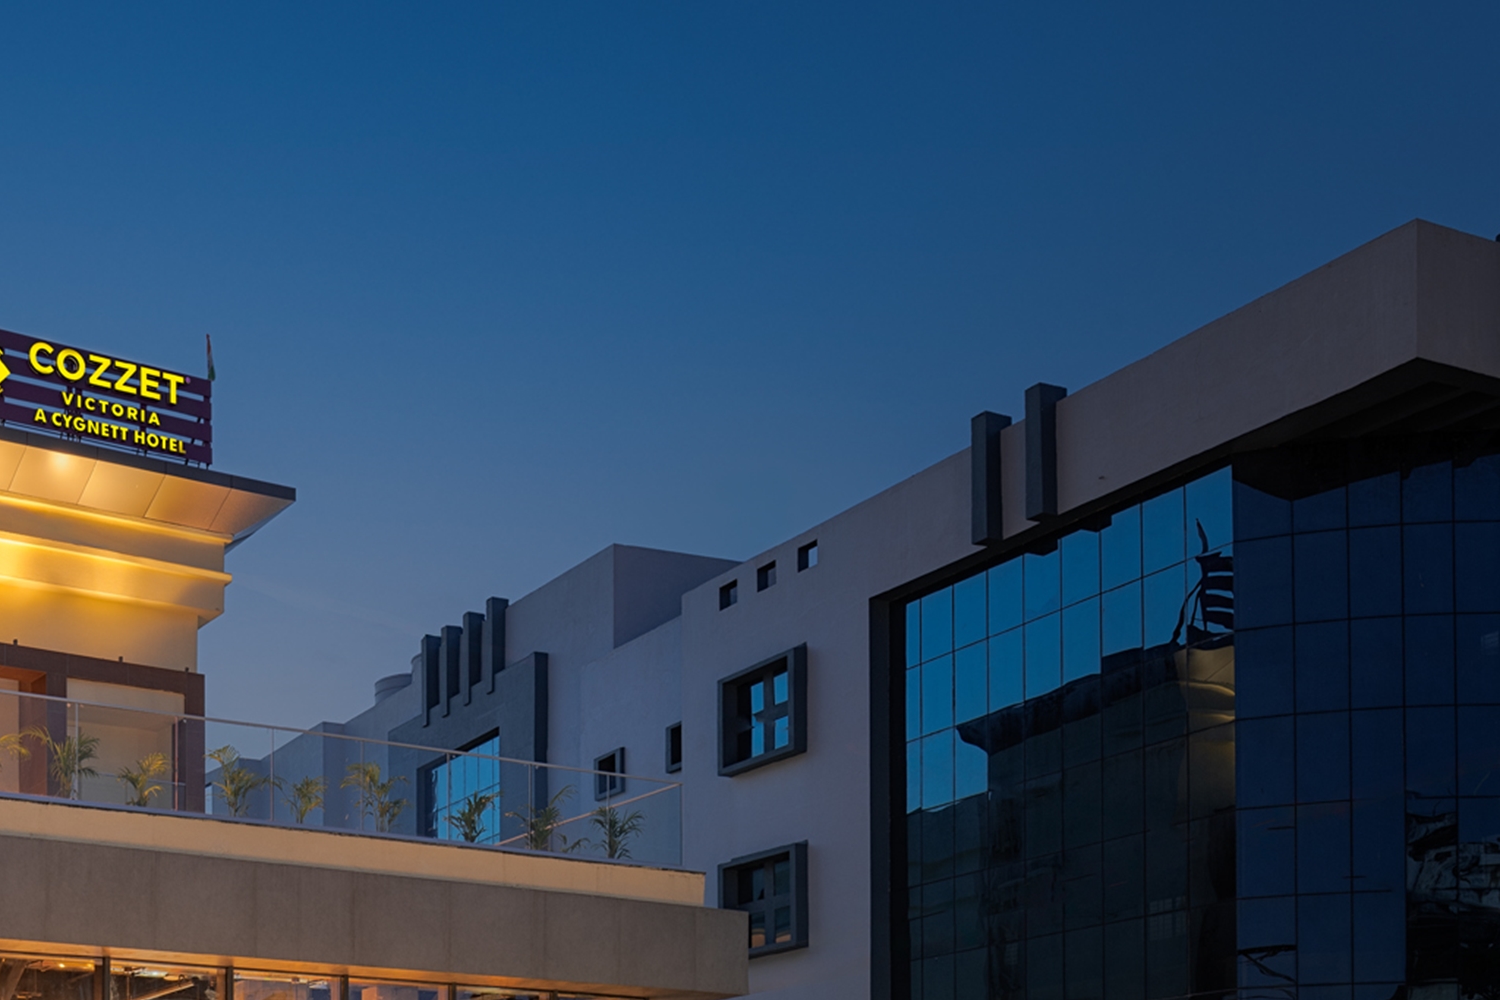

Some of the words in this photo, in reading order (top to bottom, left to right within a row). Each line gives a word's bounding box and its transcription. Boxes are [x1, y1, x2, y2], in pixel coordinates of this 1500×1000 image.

[29, 341, 185, 405] COZZET
[34, 408, 48, 423] A
[51, 411, 129, 441] CYGNETT
[134, 430, 186, 454] HOTEL
[61, 391, 161, 426] VICTORIA
